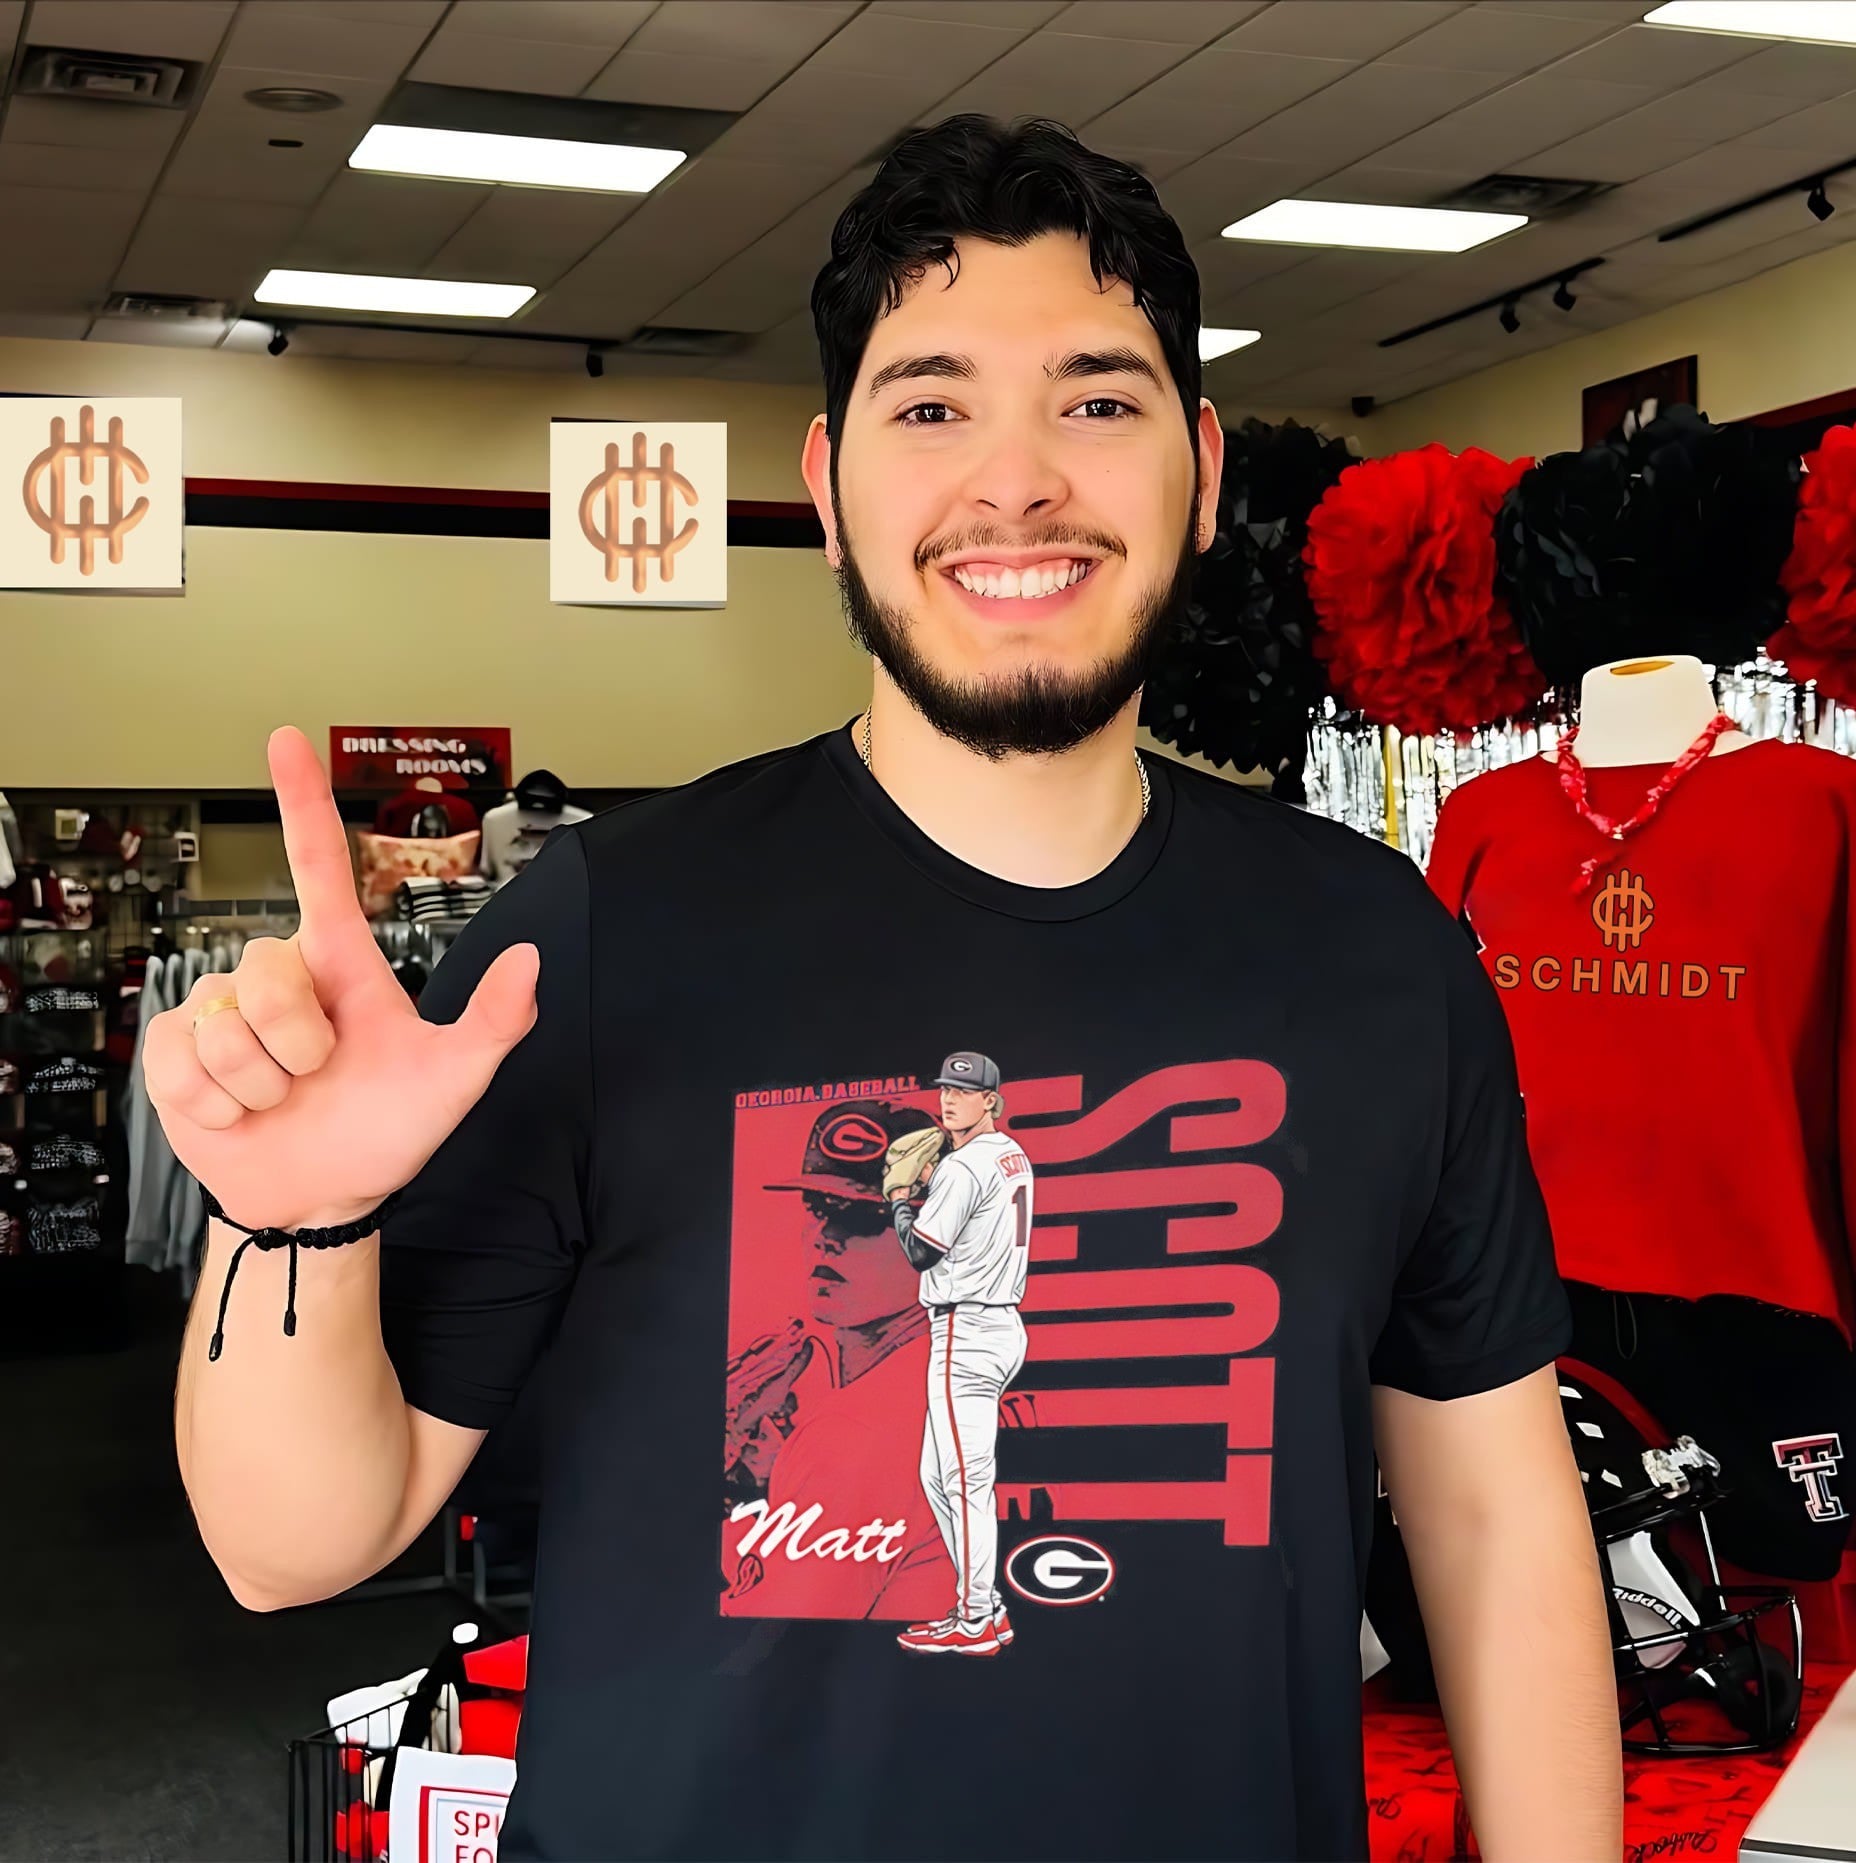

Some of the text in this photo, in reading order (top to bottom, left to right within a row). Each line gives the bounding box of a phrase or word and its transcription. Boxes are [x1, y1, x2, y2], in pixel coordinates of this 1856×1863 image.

[342, 738, 467, 754] DRESSING
[396, 759, 487, 775] ROOMS
[1493, 953, 1747, 1000] SCHMIDT
[1012, 1185, 1027, 1247] 1
[997, 1059, 1287, 1547] SCOTT
[730, 1499, 907, 1563] Matt
